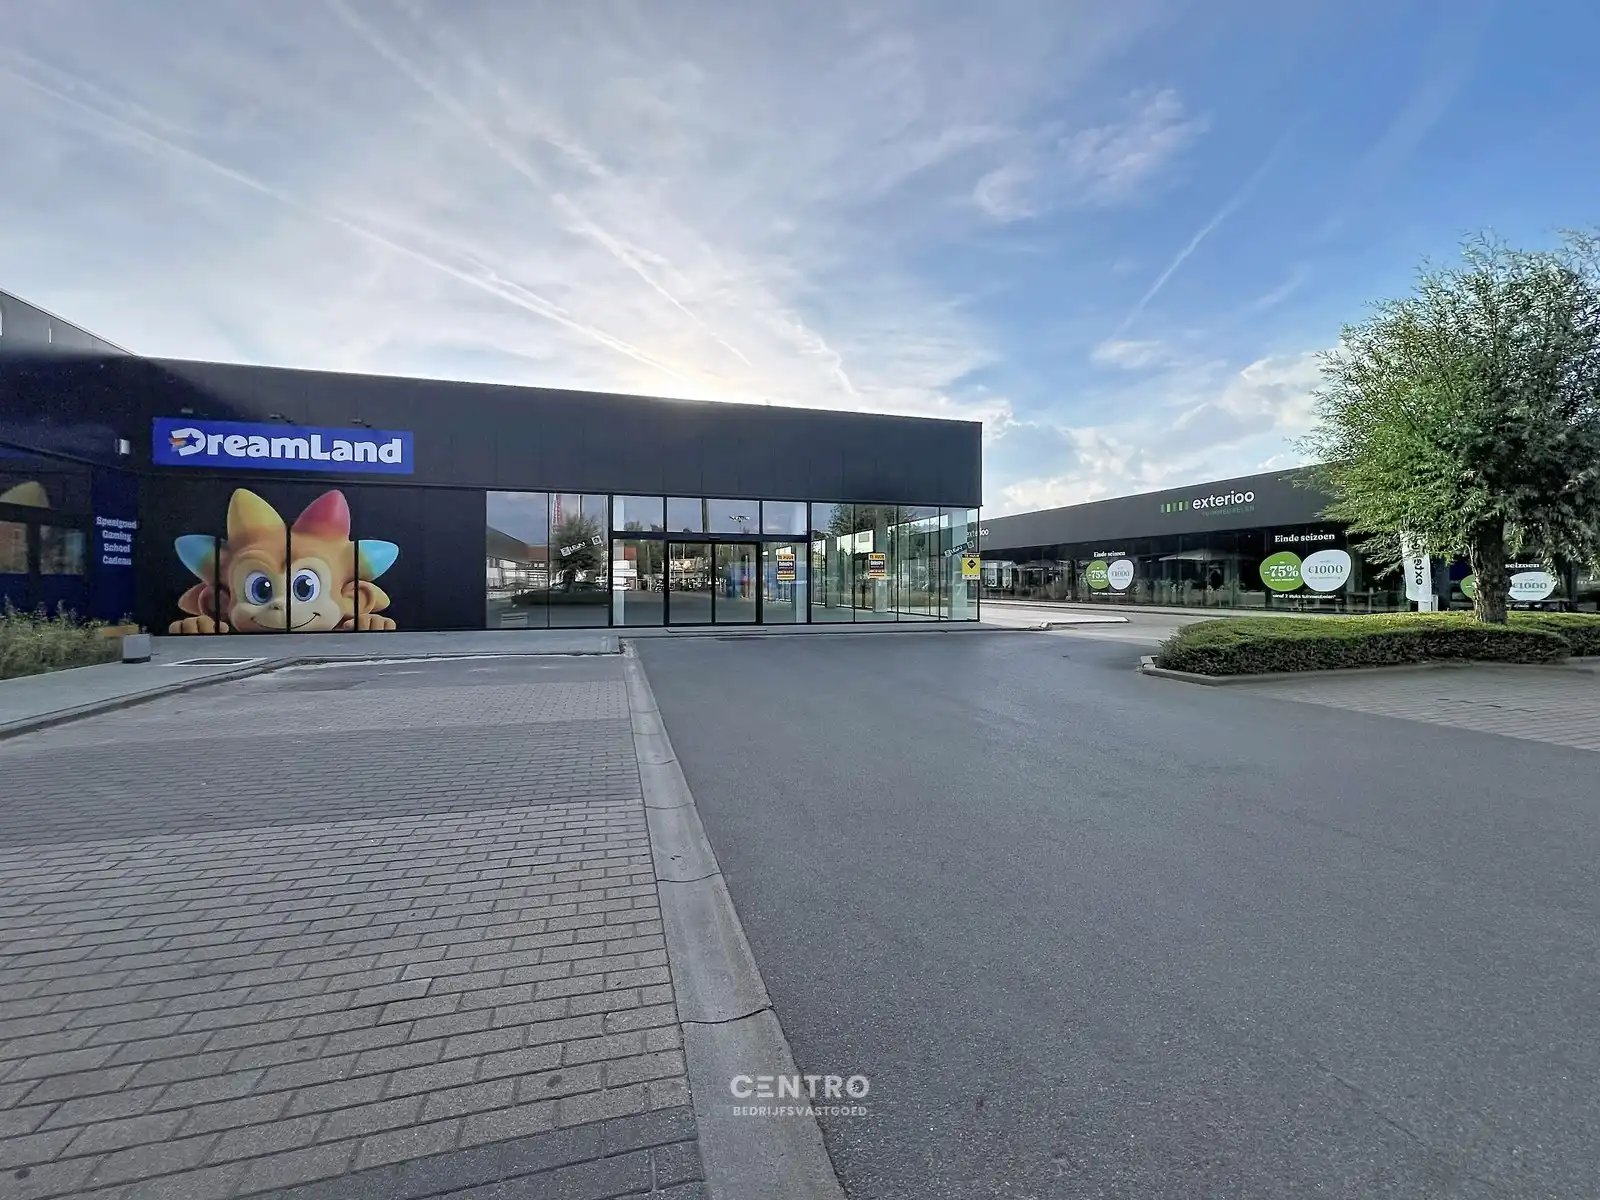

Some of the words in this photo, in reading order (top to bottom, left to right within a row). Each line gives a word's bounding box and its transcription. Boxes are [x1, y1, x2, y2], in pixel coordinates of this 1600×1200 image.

[170, 428, 402, 463] DreamLand
[1192, 490, 1255, 509] exterioo
[102, 530, 132, 542] Gaming
[1274, 534, 1299, 542] Einde
[1300, 533, 1336, 541] seizoen
[104, 543, 130, 552] School
[1263, 565, 1299, 577] -75%
